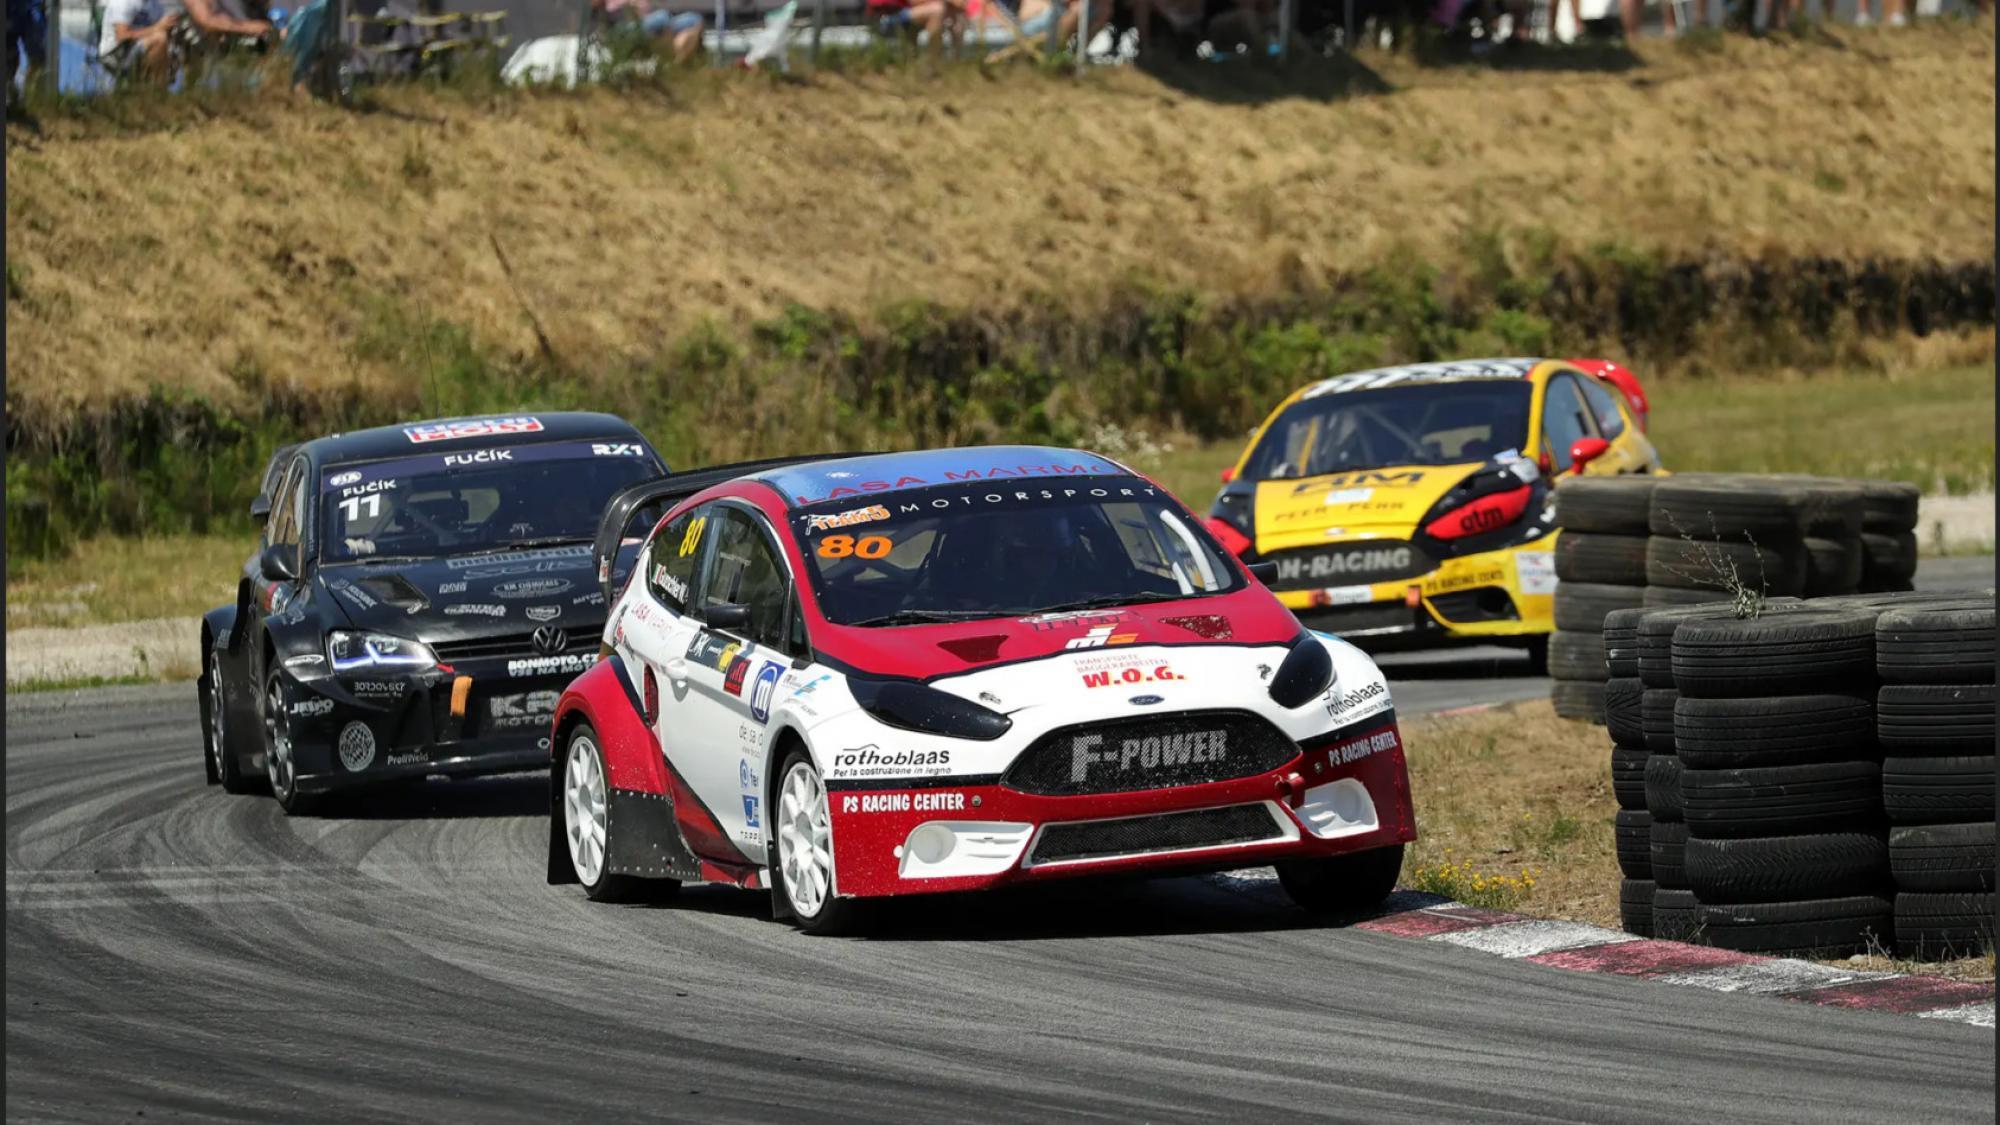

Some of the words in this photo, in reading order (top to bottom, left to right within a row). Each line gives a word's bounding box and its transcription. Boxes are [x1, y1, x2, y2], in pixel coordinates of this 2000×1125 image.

[444, 449, 513, 466] FUČÍK
[591, 443, 644, 456] RX1
[342, 479, 397, 498] FUČÍK
[797, 476, 928, 505] LASA
[338, 493, 381, 521] 11
[1460, 507, 1505, 532] atm
[679, 516, 706, 558] 80
[816, 534, 893, 560] 80
[508, 653, 600, 670] BONMOTO.CZ
[1082, 666, 1185, 689] W.O.G.
[1326, 680, 1385, 717] rothoblaas
[834, 750, 950, 767] rothoblaas
[1071, 729, 1228, 783] F-POWER
[1328, 749, 1342, 768] PS
[1342, 739, 1371, 764] RACING
[1371, 731, 1398, 753] CENTER
[833, 768, 848, 777] Per
[850, 768, 858, 776] la
[860, 766, 912, 776] costruzione
[914, 767, 924, 775] in
[925, 767, 952, 775] legno
[842, 795, 859, 814] PS
[862, 793, 911, 813] RACING
[913, 791, 965, 811] CENTER
